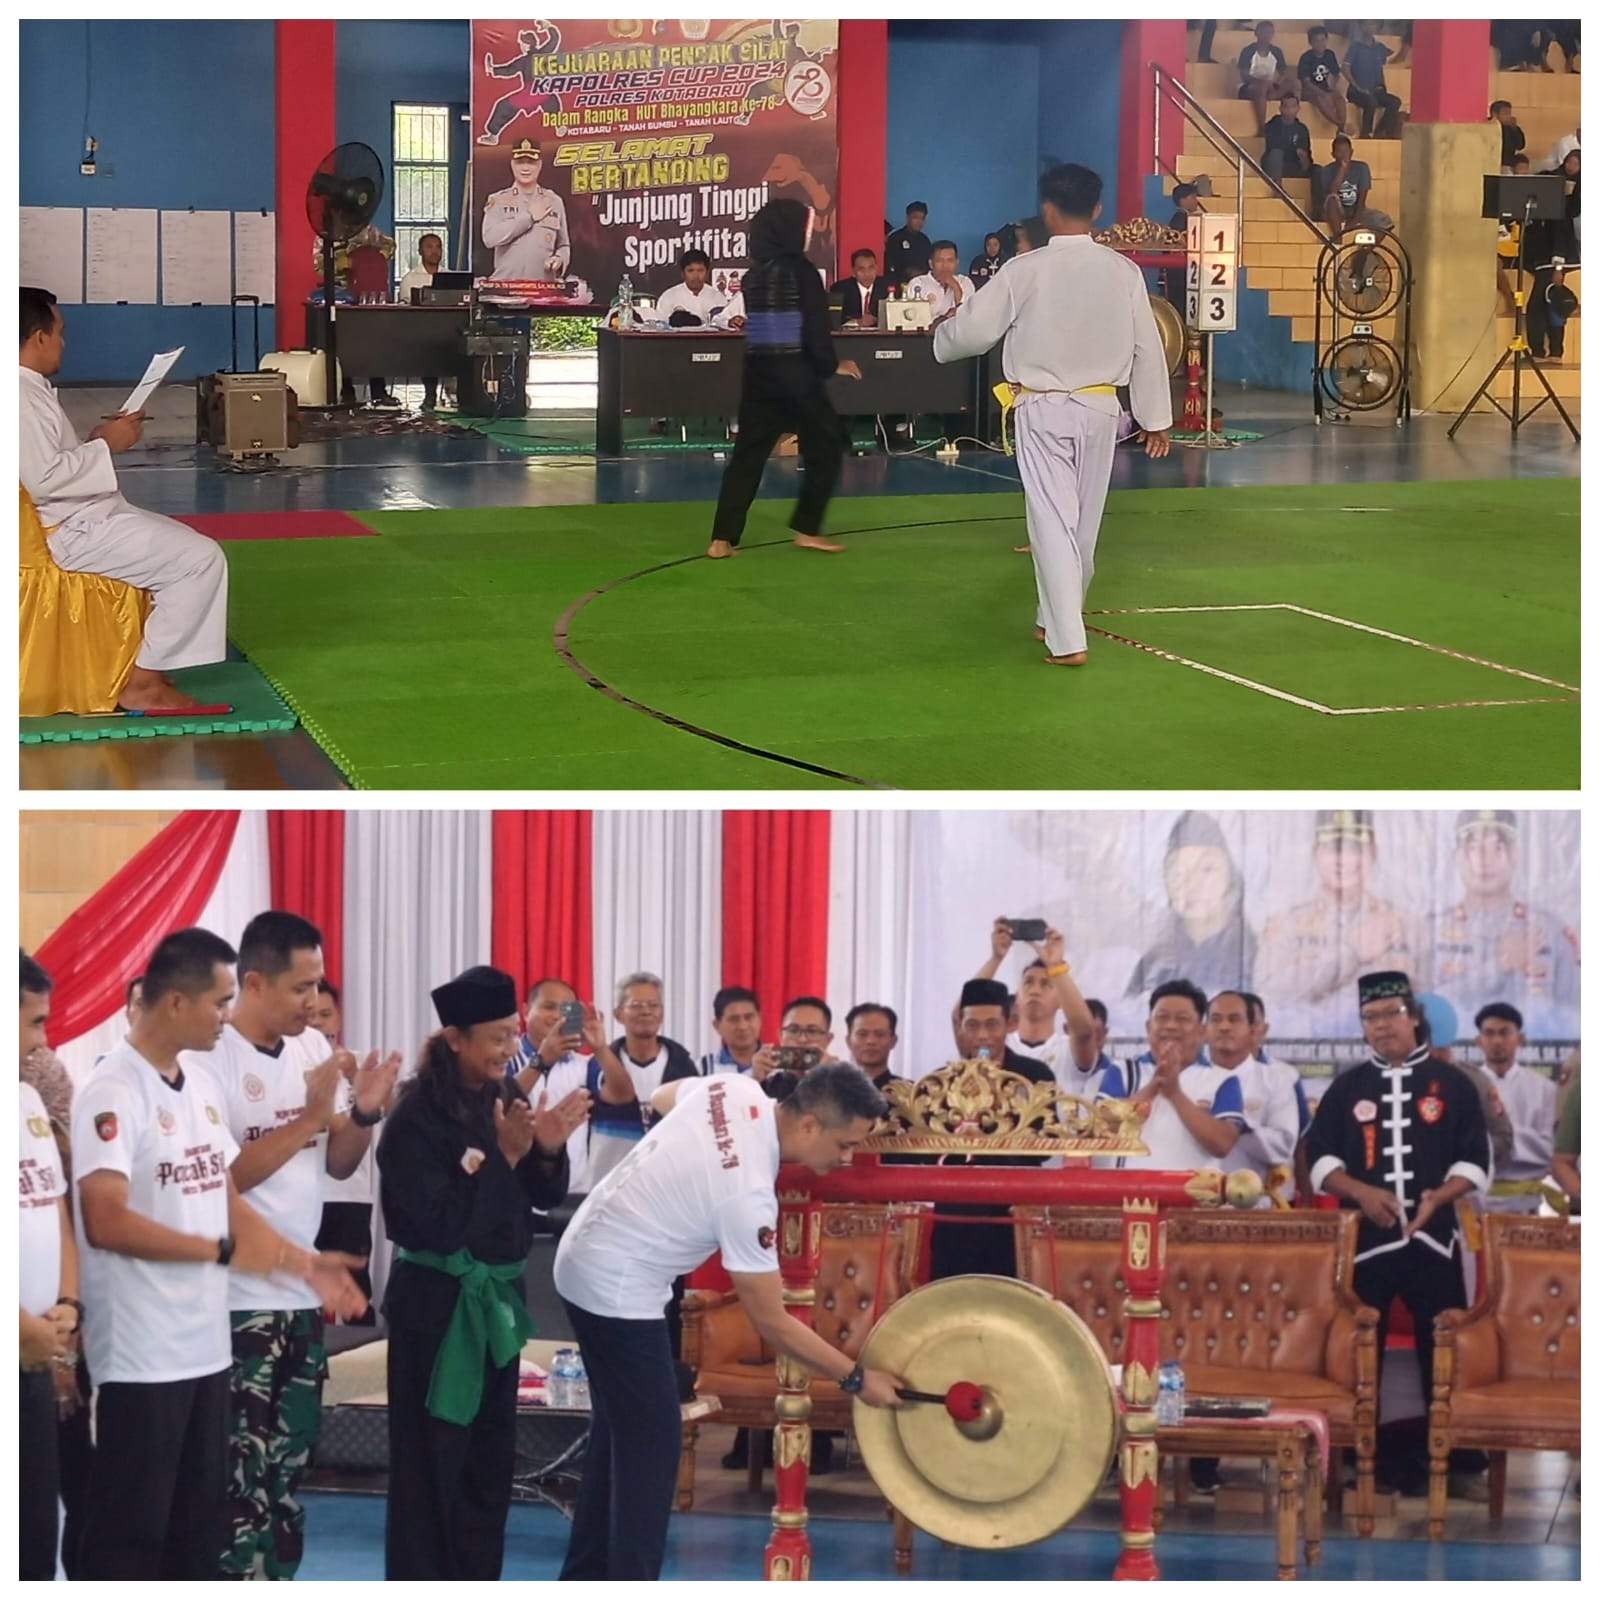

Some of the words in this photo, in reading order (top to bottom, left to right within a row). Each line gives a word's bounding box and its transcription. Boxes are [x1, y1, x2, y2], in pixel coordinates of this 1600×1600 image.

[533, 49, 652, 76] KEJUARAAN
[659, 43, 734, 67] PENCAK
[740, 40, 789, 61] SILAT
[530, 70, 665, 95] KAPOLRES
[668, 65, 720, 86] CUP
[722, 60, 787, 82] 2024
[574, 90, 646, 108] POLRES
[649, 82, 746, 103] KOTABARU
[542, 110, 580, 127] Dalam
[584, 106, 629, 125] Rangka
[637, 104, 656, 121] HUT
[661, 99, 737, 119] Bhayangkara
[567, 125, 612, 136] KOTABARU
[619, 123, 646, 133] TANAH
[685, 118, 712, 127] TANAH
[713, 115, 734, 125] LAUT
[554, 134, 714, 166] SELAMAT
[572, 153, 731, 194] BERTANDING
[699, 181, 769, 222] Tinggi
[1191, 225, 1197, 249] 1
[1213, 230, 1225, 252] 1
[624, 227, 750, 274] Sportifita
[1190, 260, 1197, 285] 2
[1210, 263, 1226, 286] 2
[1189, 296, 1196, 319] 3
[1209, 297, 1225, 321] 3
